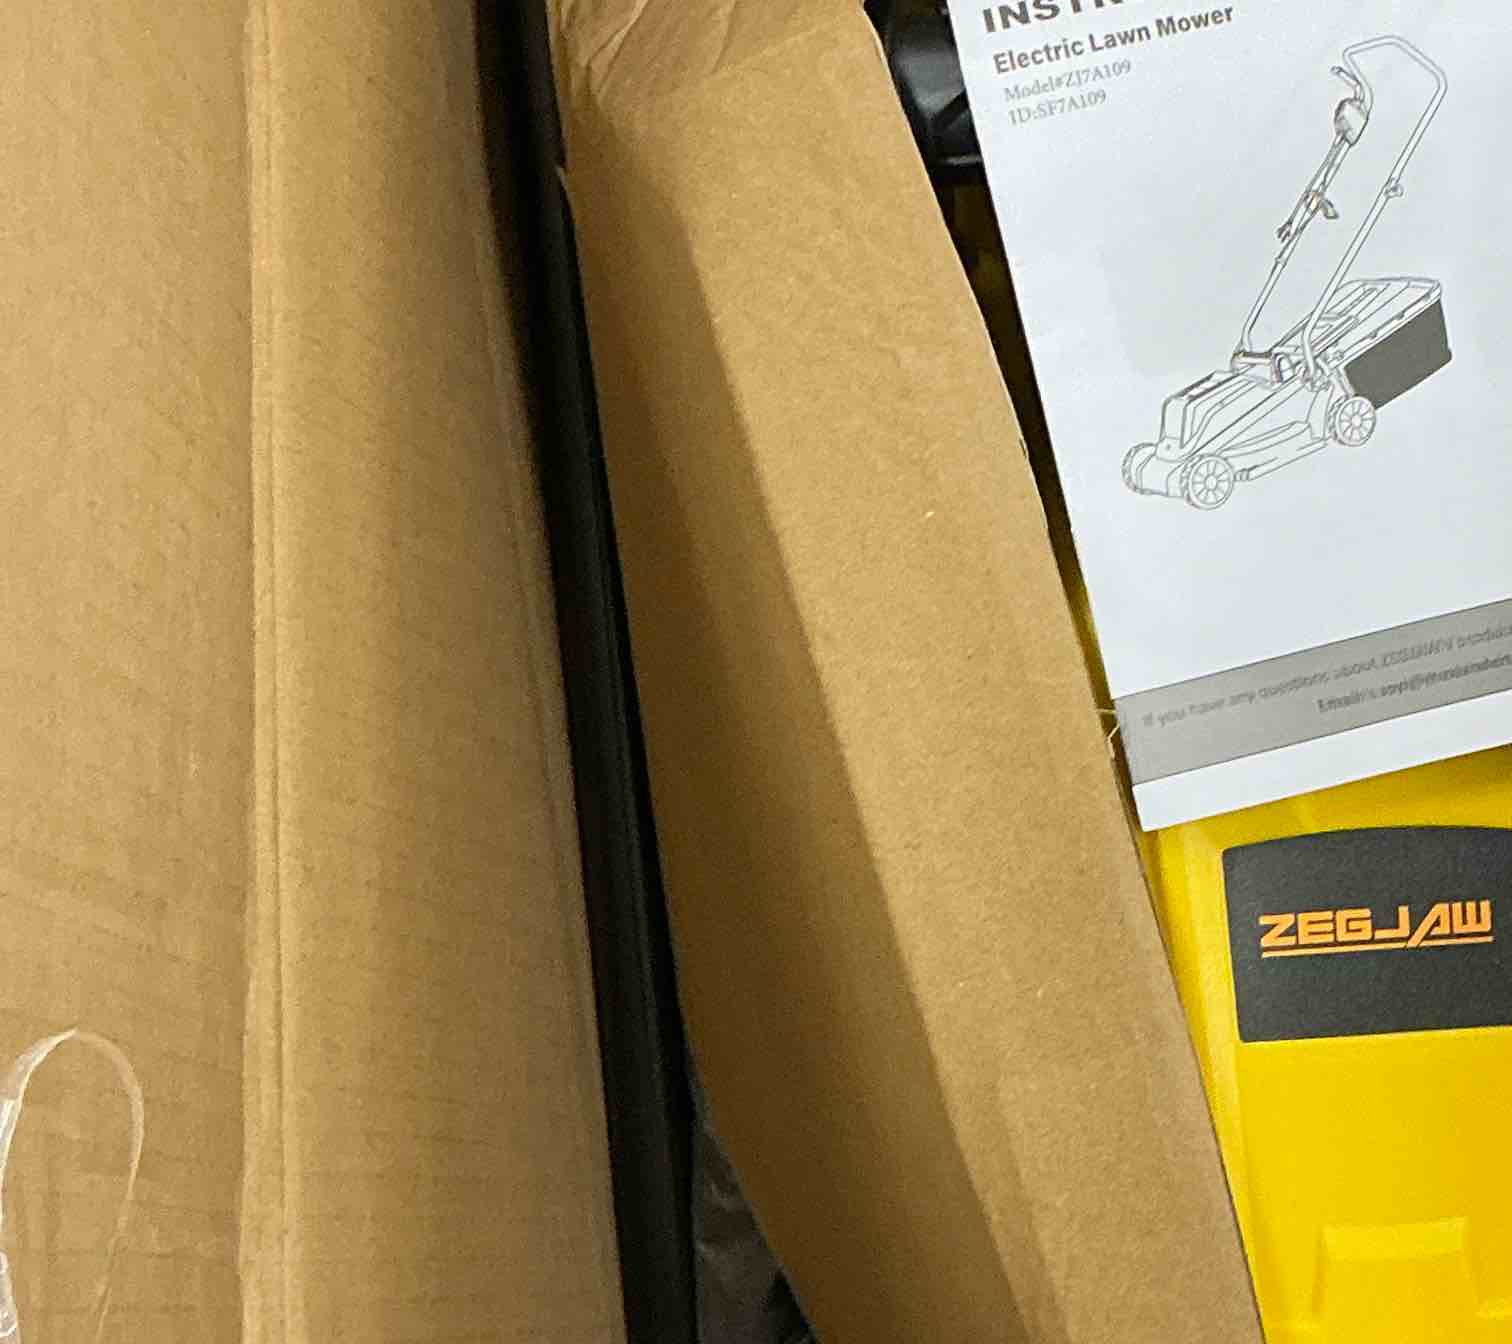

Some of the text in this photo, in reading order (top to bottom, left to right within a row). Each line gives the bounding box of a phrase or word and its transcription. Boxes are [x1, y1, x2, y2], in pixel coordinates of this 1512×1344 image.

[993, 6, 1235, 75] Electric Lawn Mower
[1258, 898, 1493, 949] ZEGJAW
